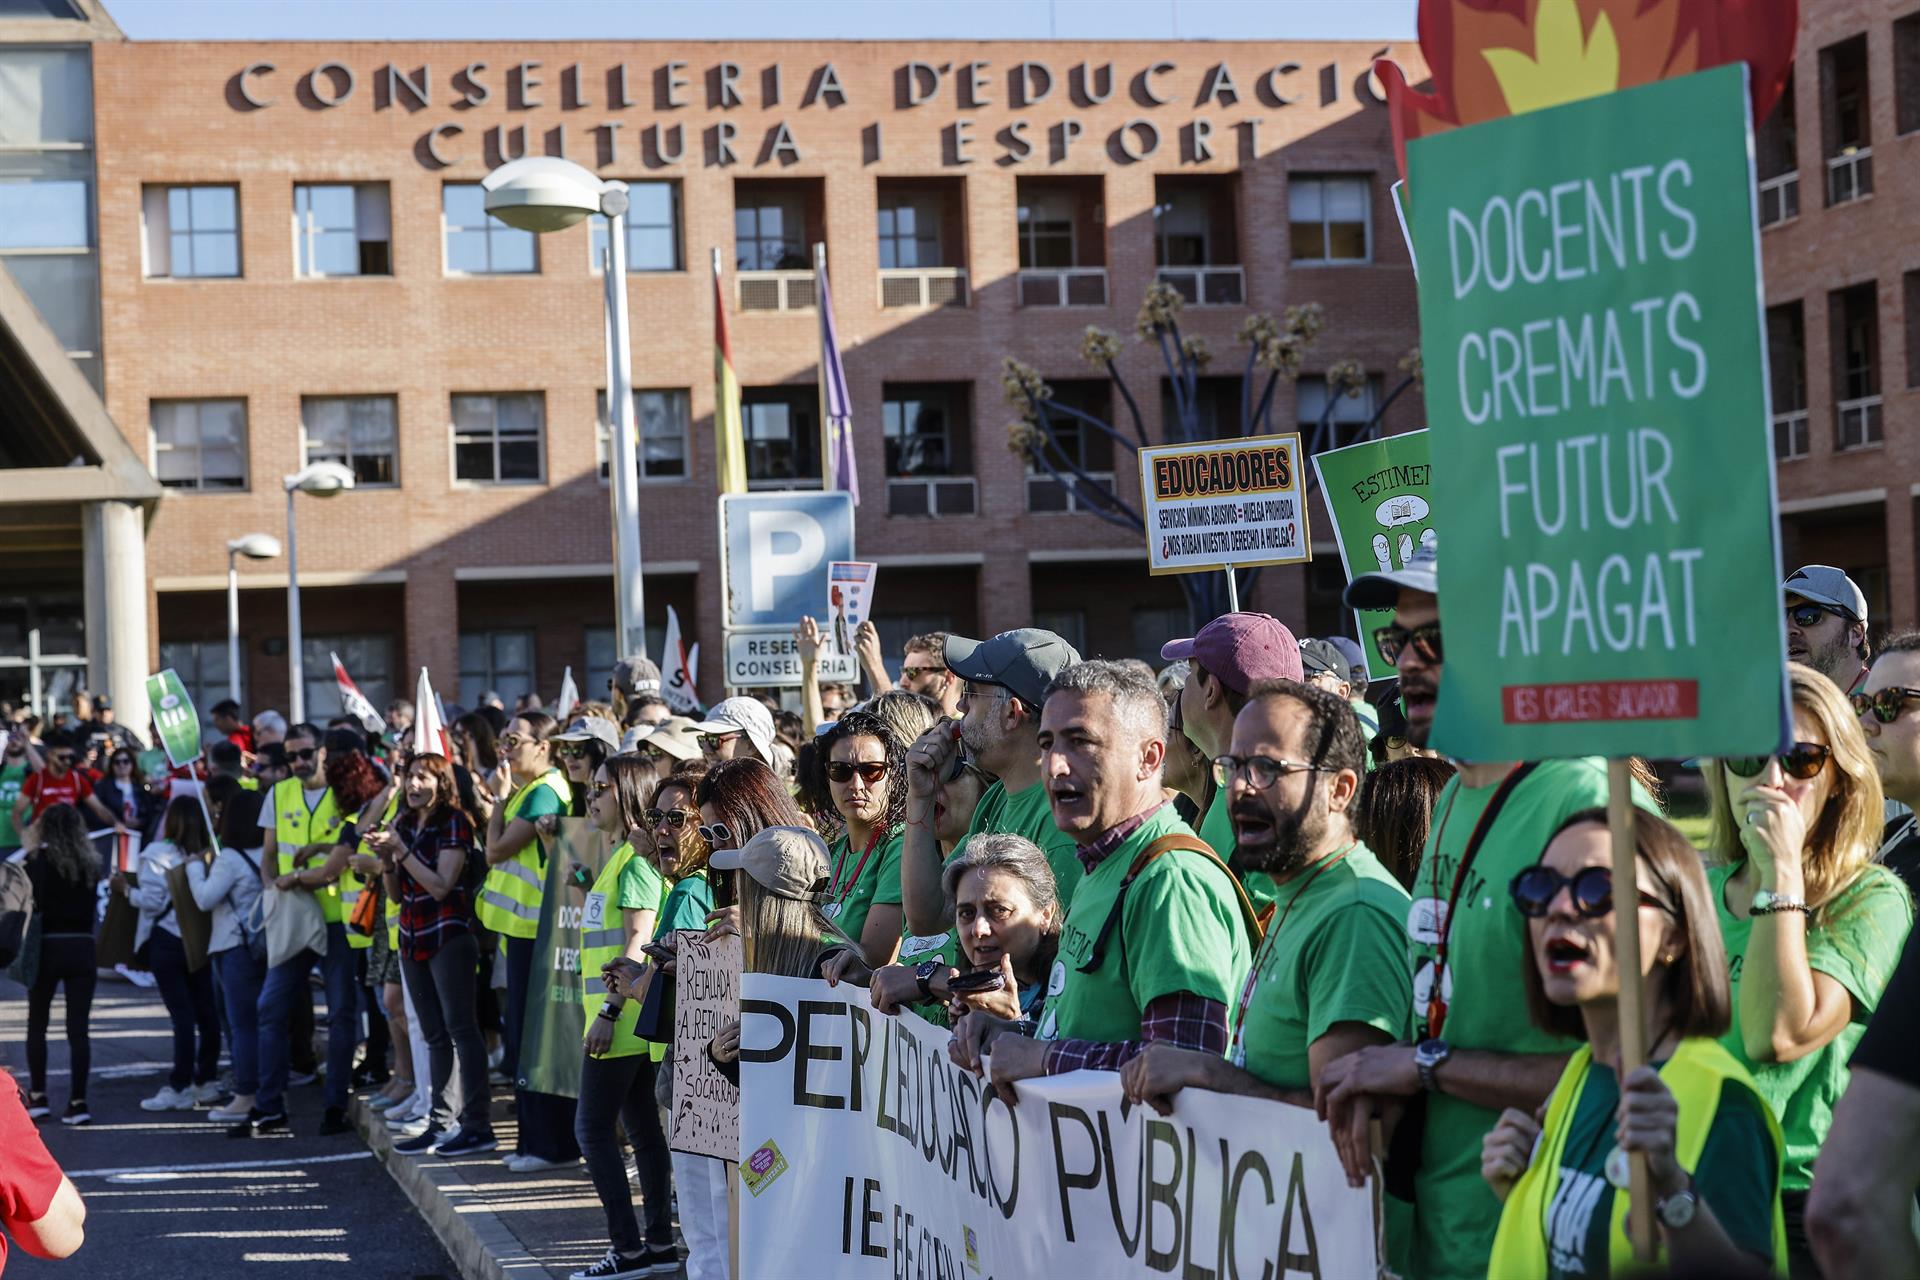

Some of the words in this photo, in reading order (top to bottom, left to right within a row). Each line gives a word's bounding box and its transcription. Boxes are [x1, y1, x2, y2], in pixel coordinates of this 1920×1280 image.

[234, 61, 848, 108] CONSELLERIA
[950, 117, 1264, 165] ESPORT
[1447, 158, 1698, 300] DOCENTS
[1457, 291, 1708, 425] CREMATS
[1154, 448, 1291, 497] EDUCADORES
[1496, 428, 1678, 538] FUTUR
[1159, 508, 1187, 530] SERVICIOS
[1187, 502, 1210, 527] MÍNIMOS
[1211, 503, 1238, 526] ABUSIVOS
[1243, 501, 1265, 523] HUELGA
[1265, 498, 1294, 522] PROHIBIDA
[749, 510, 826, 612] P
[1181, 531, 1202, 555] ROBAN
[1201, 529, 1230, 554] NUESTRO
[1231, 526, 1260, 551] DERECHO
[1261, 527, 1266, 549] A
[1265, 522, 1296, 549] HUELGA?
[1498, 548, 1704, 658] APAGAT
[736, 659, 848, 677] CONSELRIA
[748, 638, 833, 656] RESERT
[686, 954, 733, 1001] RETALLADA
[678, 1009, 690, 1040] A
[738, 998, 871, 1112] PER
